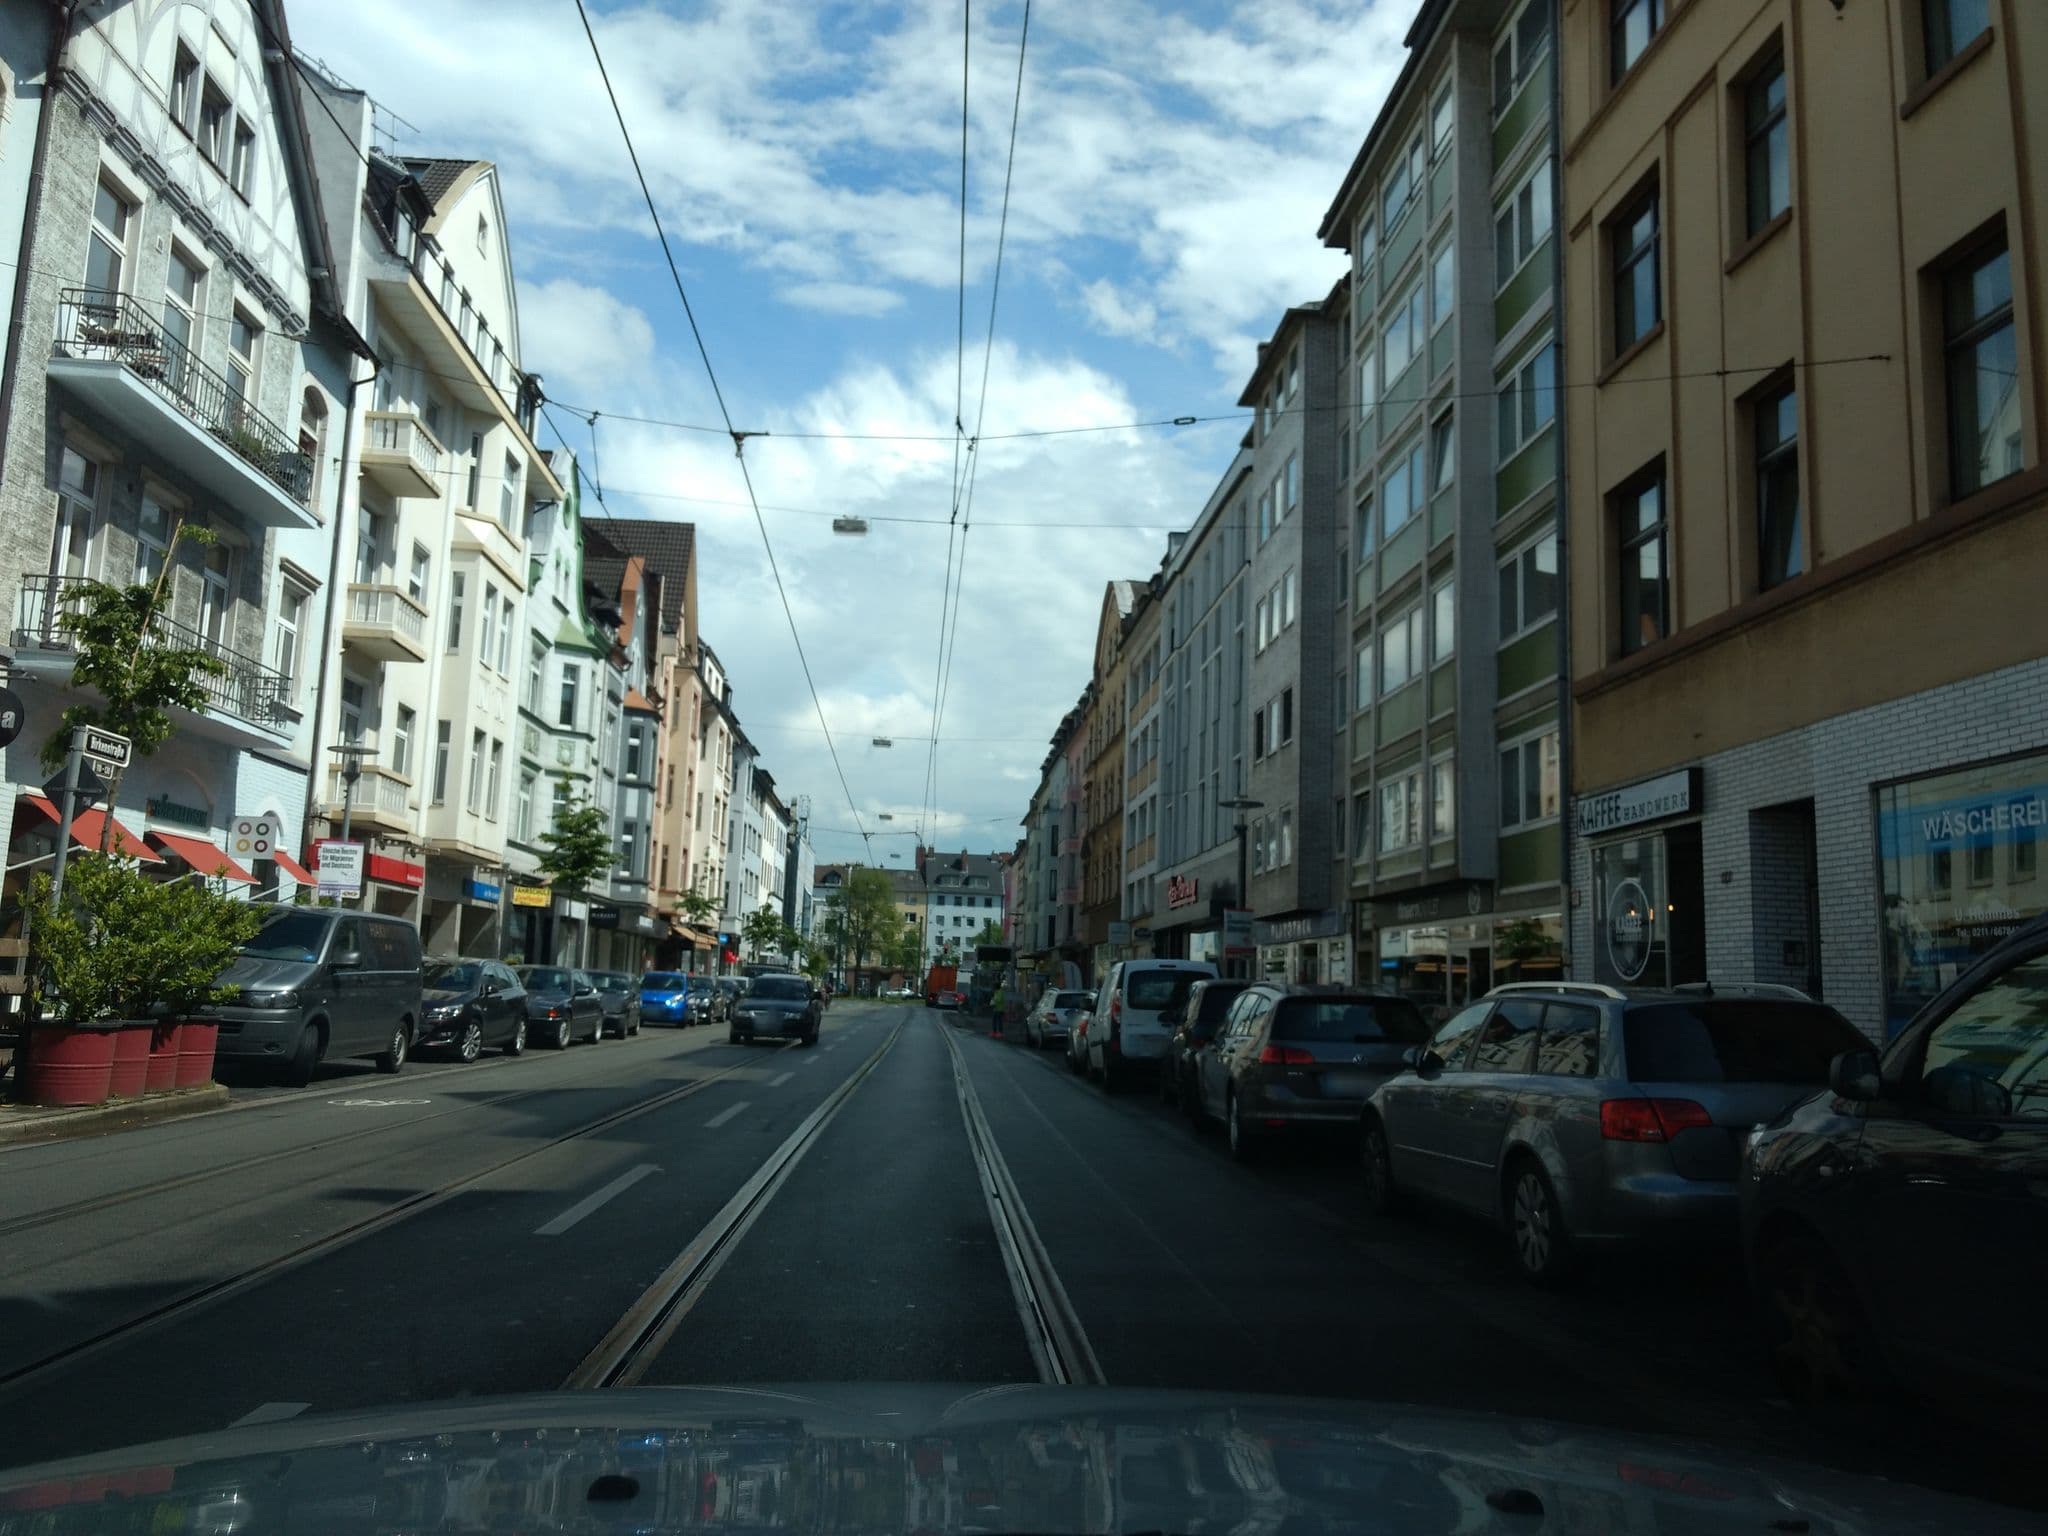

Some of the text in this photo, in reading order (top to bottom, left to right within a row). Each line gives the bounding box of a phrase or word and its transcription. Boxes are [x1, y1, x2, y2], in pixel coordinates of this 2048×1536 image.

[90, 735, 125, 759] Birkenstraße
[1578, 792, 1687, 831] KAFFEE HANDWERK
[1922, 799, 2047, 841] WÄSCHEREI
